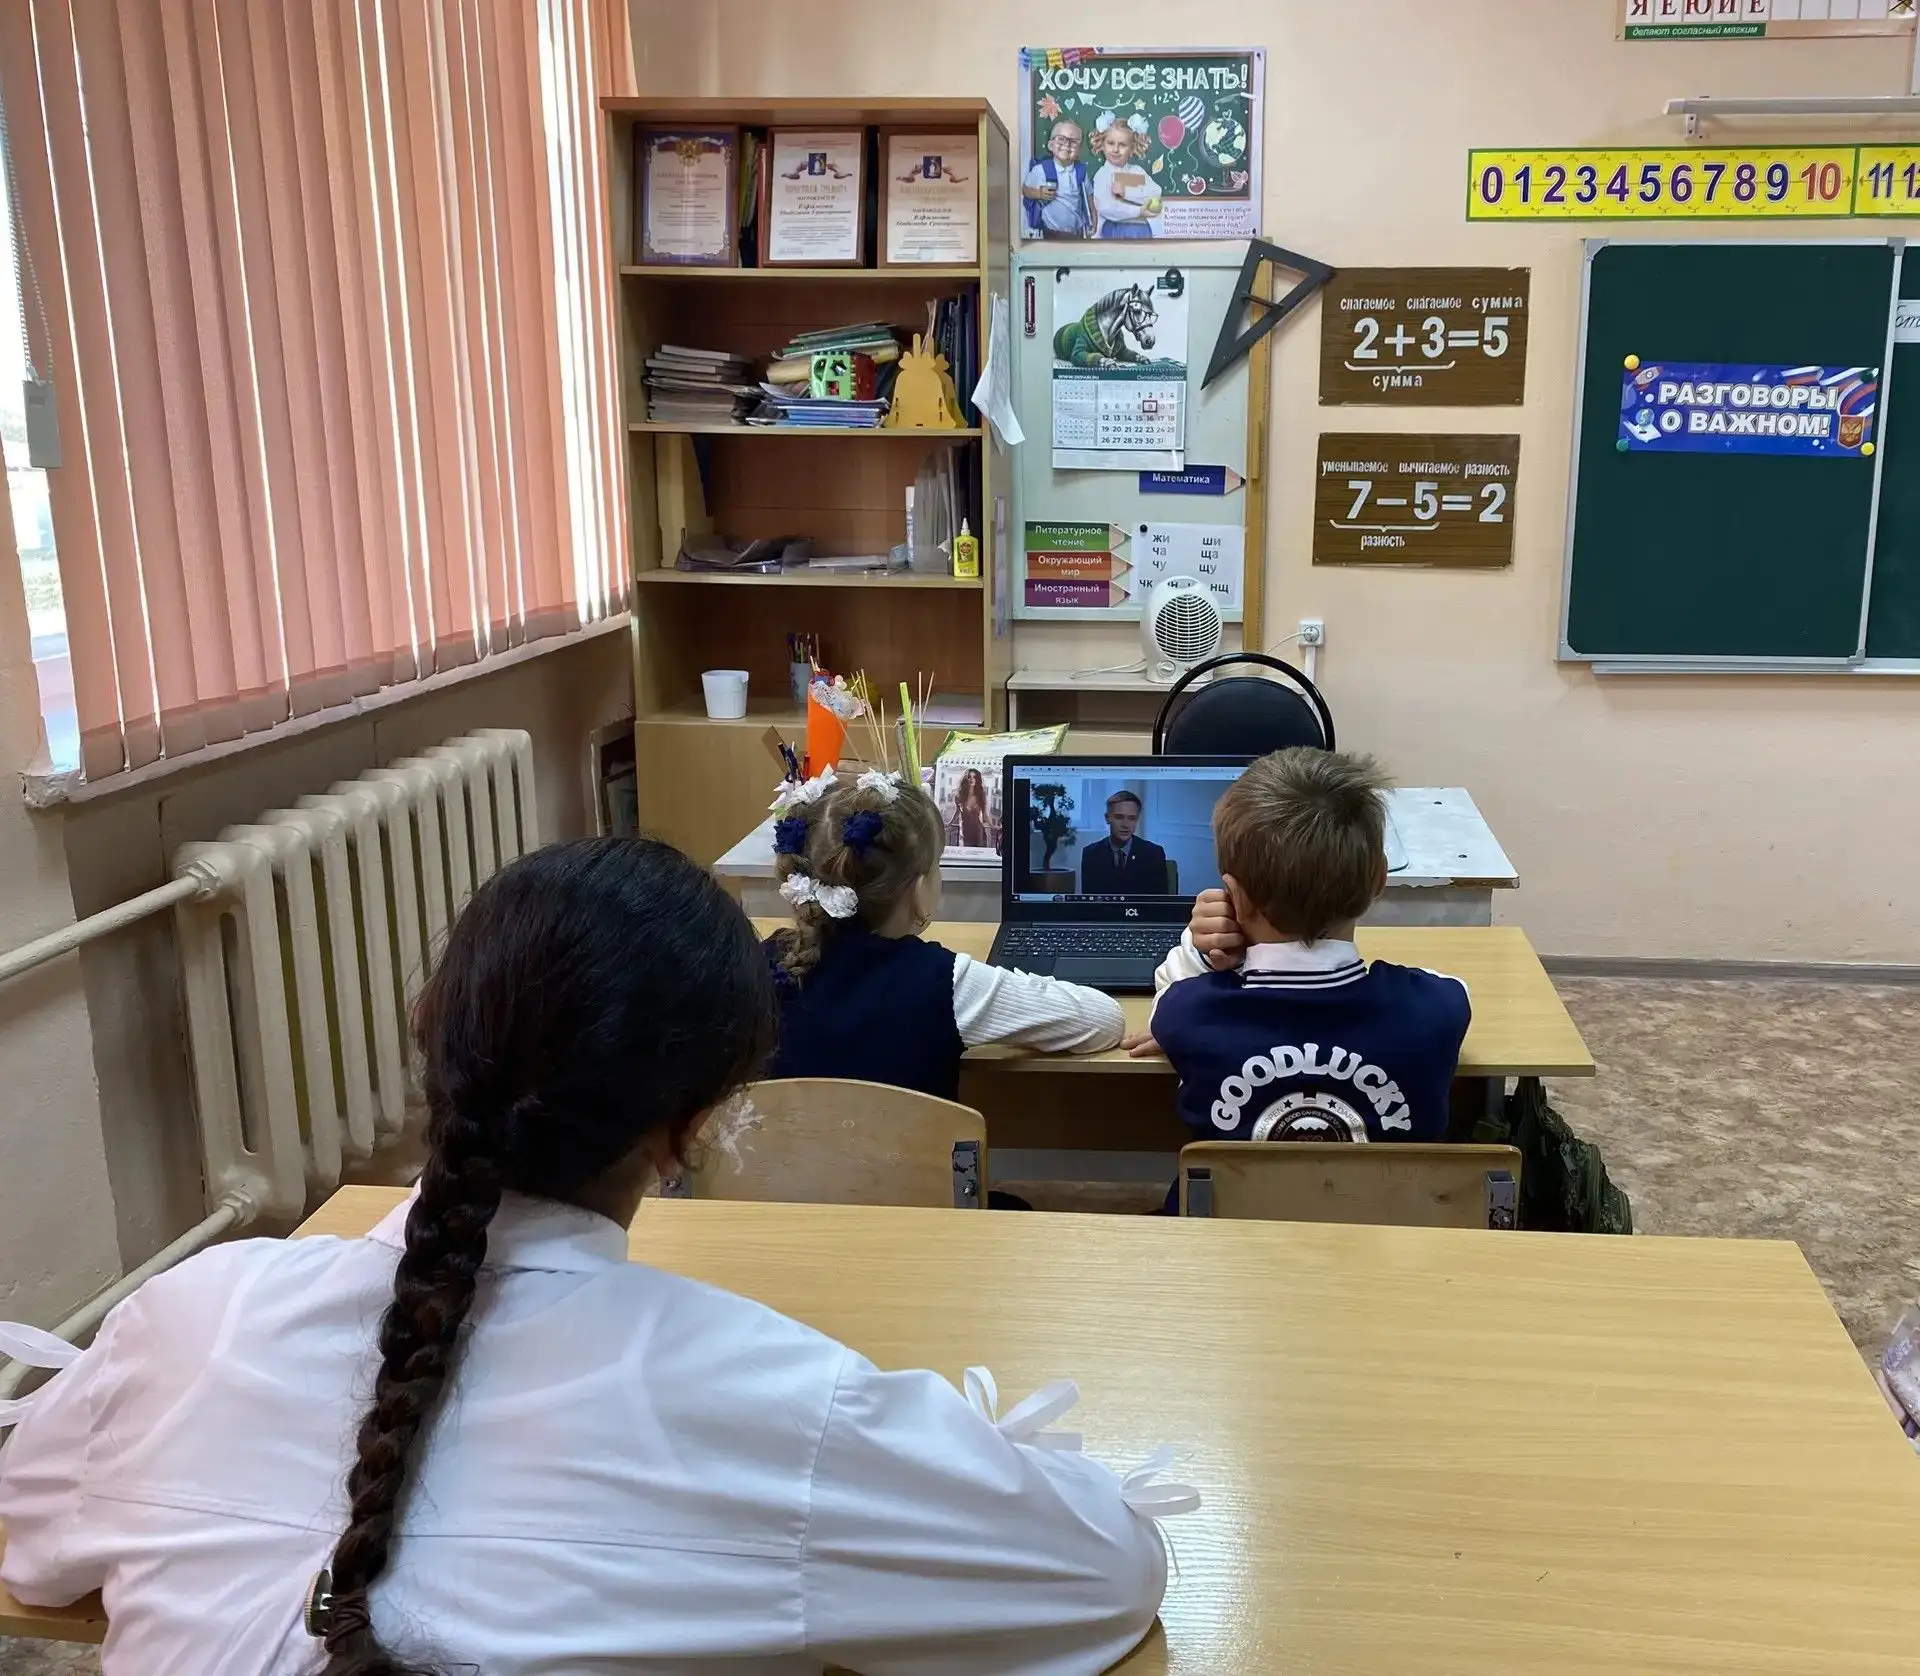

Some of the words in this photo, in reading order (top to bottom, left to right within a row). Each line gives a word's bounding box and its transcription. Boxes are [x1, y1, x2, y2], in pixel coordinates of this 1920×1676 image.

[1632, 27, 1670, 36] делают
[1672, 26, 1721, 35] согласный
[1723, 26, 1758, 34] мягким
[1038, 68, 1108, 90] ХОЧУ
[1111, 64, 1156, 89] ВСЁ
[1161, 64, 1248, 89] ЗНАТЬ!
[1800, 161, 1842, 202] 10
[1340, 298, 1395, 310] слагаемое
[1407, 296, 1462, 310] слагаемое
[1472, 296, 1523, 313] сумма
[1373, 373, 1422, 392] сумма
[1659, 382, 1839, 409] РАЗГОВОРЫ
[1660, 409, 1682, 433] О
[1689, 410, 1831, 436] ВАЖНОМ!
[1322, 460, 1388, 476] уменьшаемое
[1399, 460, 1460, 474] вычитаемое
[1464, 462, 1510, 479] разность
[1152, 472, 1210, 485] Математика
[1035, 525, 1102, 537] Литературное
[1152, 534, 1170, 543] жи
[1203, 537, 1221, 546] ши
[1361, 534, 1405, 550] разность
[1152, 547, 1167, 556] ча
[1201, 550, 1219, 560] ща
[1038, 555, 1102, 567] Окружающий
[1152, 560, 1167, 571] чу
[1199, 564, 1217, 575] щу
[1061, 569, 1080, 578] мир
[1034, 583, 1100, 593] Иностранный
[1139, 579, 1153, 588] чк
[1055, 597, 1079, 605] язык
[1211, 1042, 1412, 1131] GOODLUCKY
